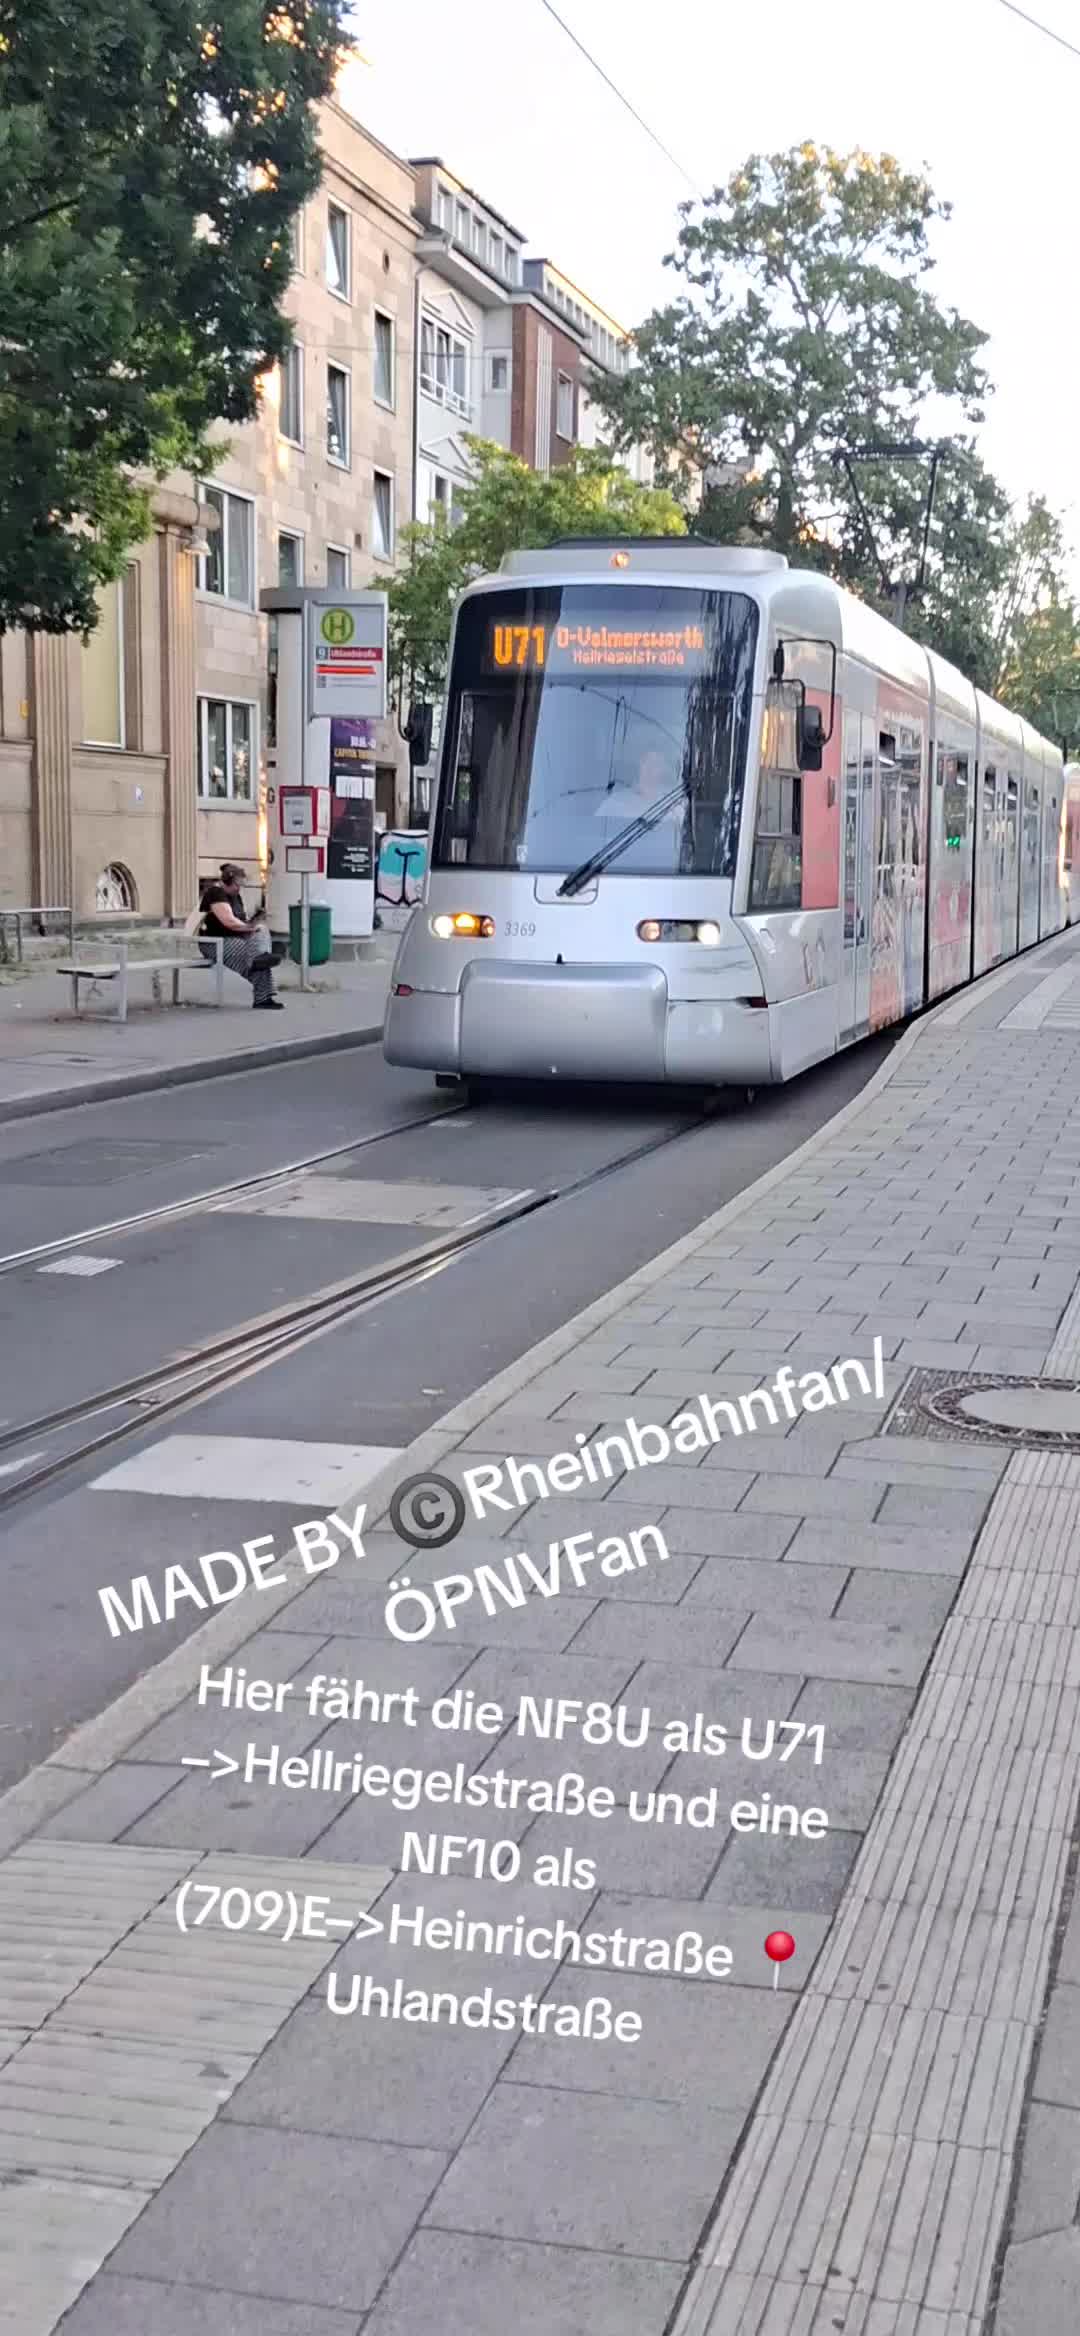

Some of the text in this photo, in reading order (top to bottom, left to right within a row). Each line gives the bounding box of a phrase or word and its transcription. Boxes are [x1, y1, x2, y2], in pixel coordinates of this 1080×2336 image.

[329, 615, 345, 636] H
[494, 626, 546, 665] U71
[503, 921, 537, 937] 3369
